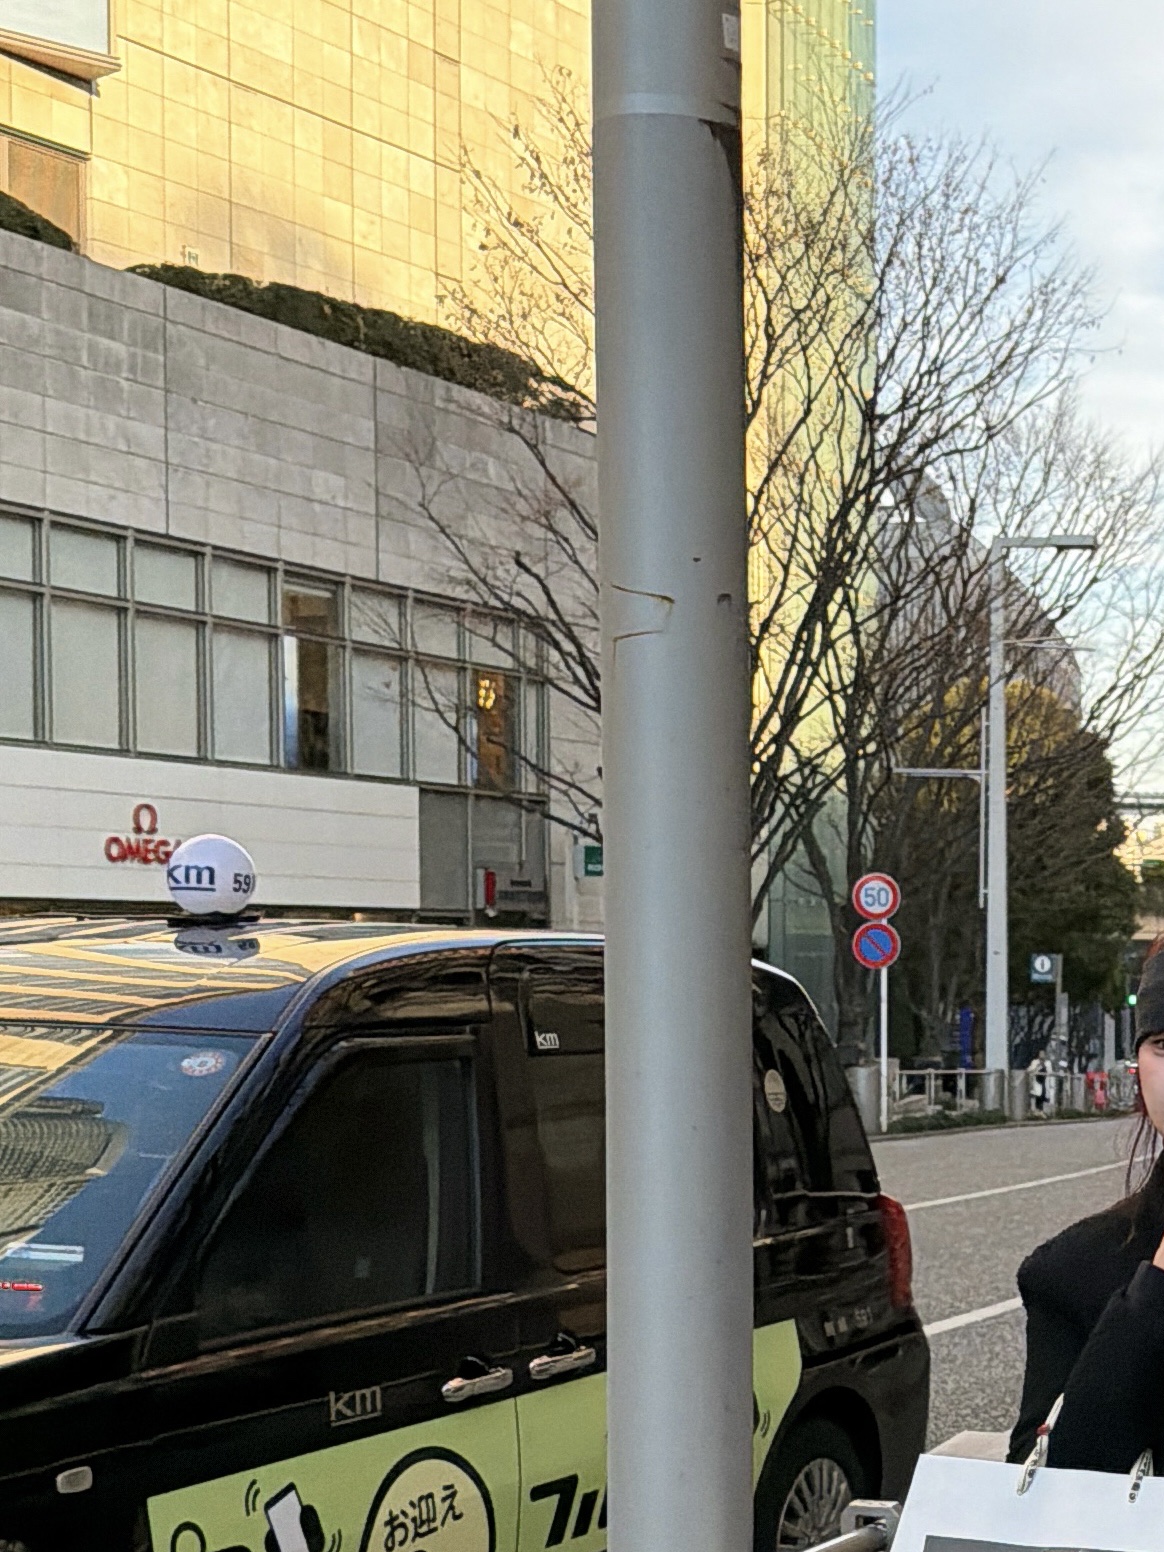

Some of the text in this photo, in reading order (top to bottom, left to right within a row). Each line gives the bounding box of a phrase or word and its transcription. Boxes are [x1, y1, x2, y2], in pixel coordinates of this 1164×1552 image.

[864, 887, 889, 908] 50
[534, 1030, 559, 1049] km
[384, 1484, 463, 1552] お迎え
